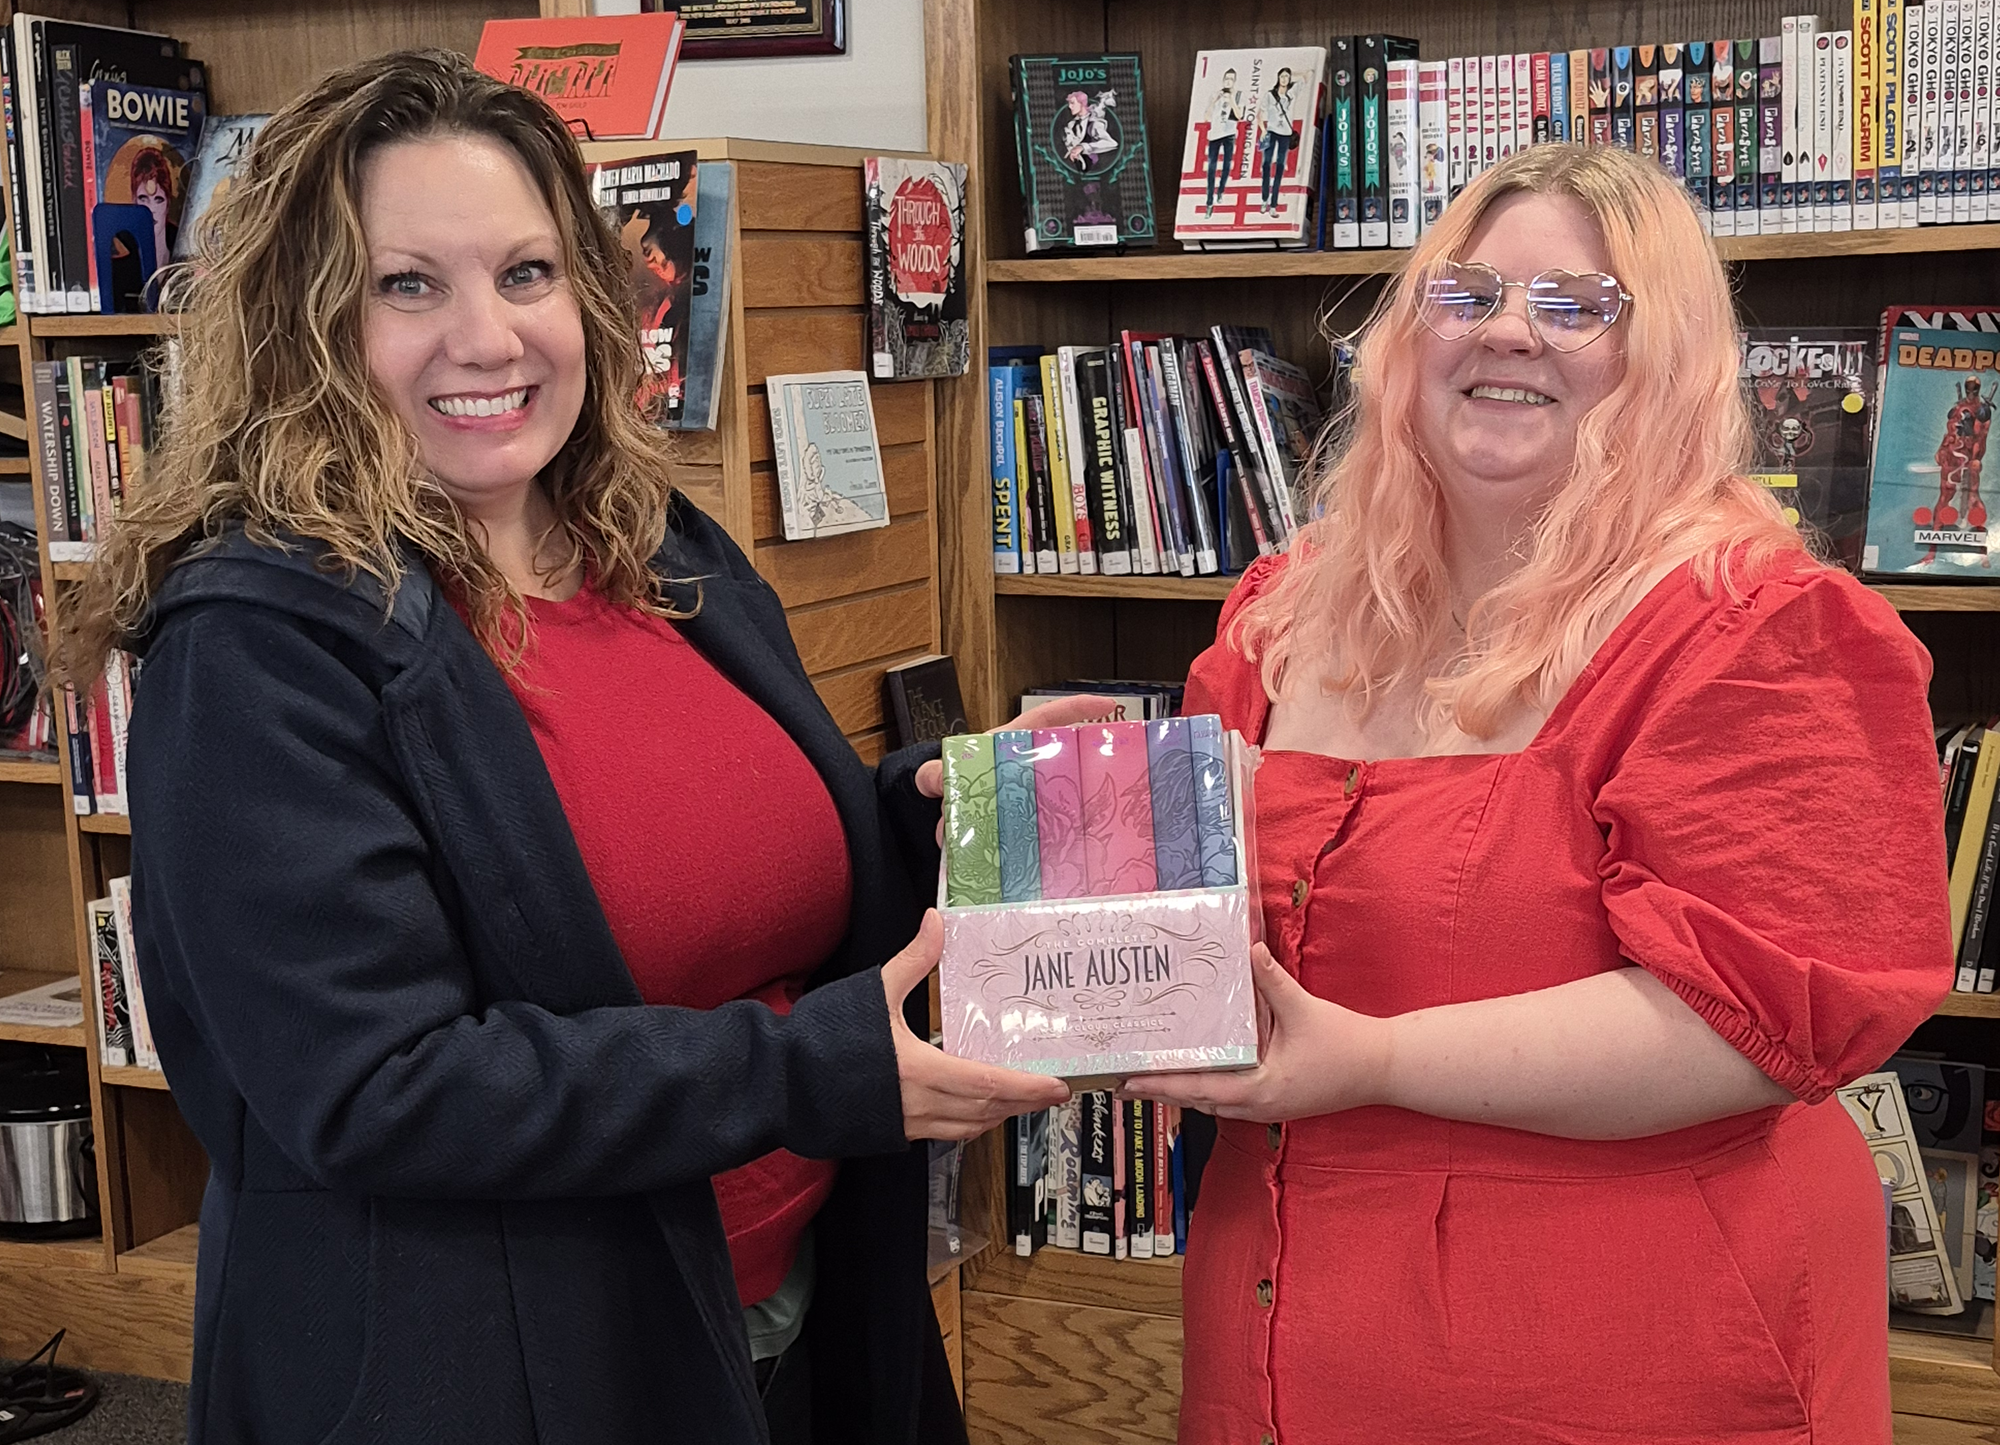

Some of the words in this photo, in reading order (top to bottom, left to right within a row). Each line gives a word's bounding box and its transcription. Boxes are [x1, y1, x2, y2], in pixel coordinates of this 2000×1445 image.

[1860, 16, 1872, 81] SCOTT
[1885, 12, 1897, 76] SCOTT
[1908, 20, 1919, 69] TOKYO
[1926, 17, 1938, 65] TOKYO
[1944, 17, 1957, 65] TOKYO
[1960, 16, 1972, 64] TOKYO
[1978, 12, 1989, 61] TOKYO
[1202, 57, 1208, 78] 1
[1249, 58, 1263, 94] SAINT
[1535, 59, 1547, 81] DEAN
[1551, 63, 1562, 84] DEAN
[1574, 58, 1584, 79] DEAN
[107, 89, 190, 128] BOWIE
[1449, 88, 1461, 134] NANA
[1466, 86, 1478, 133] NANA
[1483, 88, 1495, 135] NANA
[1499, 86, 1511, 133] NANA
[1517, 87, 1529, 130] NANA
[1535, 83, 1547, 112] KOONTZ
[1551, 86, 1563, 115] KOONTZ
[1575, 81, 1585, 110] KOONTZ
[1907, 73, 1918, 126] GHOUL
[1925, 69, 1937, 123] GHOUL
[1943, 69, 1955, 123] GHOUL
[1960, 68, 1971, 122] GHOUL
[1977, 65, 1988, 120] GHOUL
[1244, 107, 1258, 150] YOUNG
[1338, 108, 1350, 167] JOJO'S
[1366, 105, 1379, 166] JOJO'S
[1859, 86, 1872, 163] PILGRIM
[1884, 81, 1897, 159] PILGRIM
[1239, 150, 1249, 179] MEN
[895, 196, 941, 238] THROUGH
[897, 244, 943, 273] WOODS
[995, 378, 1004, 417] ALISON
[1092, 396, 1113, 467] GRAPHIC
[41, 401, 59, 482] WATERSHIP
[50, 485, 63, 532] DOWN
[994, 477, 1012, 548] SPENT
[1099, 469, 1121, 541] WITNESS
[1918, 531, 1982, 543] MARVEL
[1045, 940, 1069, 950] THE
[1077, 934, 1147, 947] COMPLETE
[1023, 951, 1076, 996] JANE
[1085, 944, 1171, 987] AUSTEN
[1113, 1019, 1164, 1030] CLASSICS
[1090, 1091, 1108, 1164] Blankets
[1133, 1118, 1143, 1130] TO
[1134, 1130, 1144, 1150] FAKE
[1060, 1128, 1082, 1229] Roaming
[1134, 1158, 1144, 1182] MOON
[1135, 1184, 1145, 1218] LANDING
